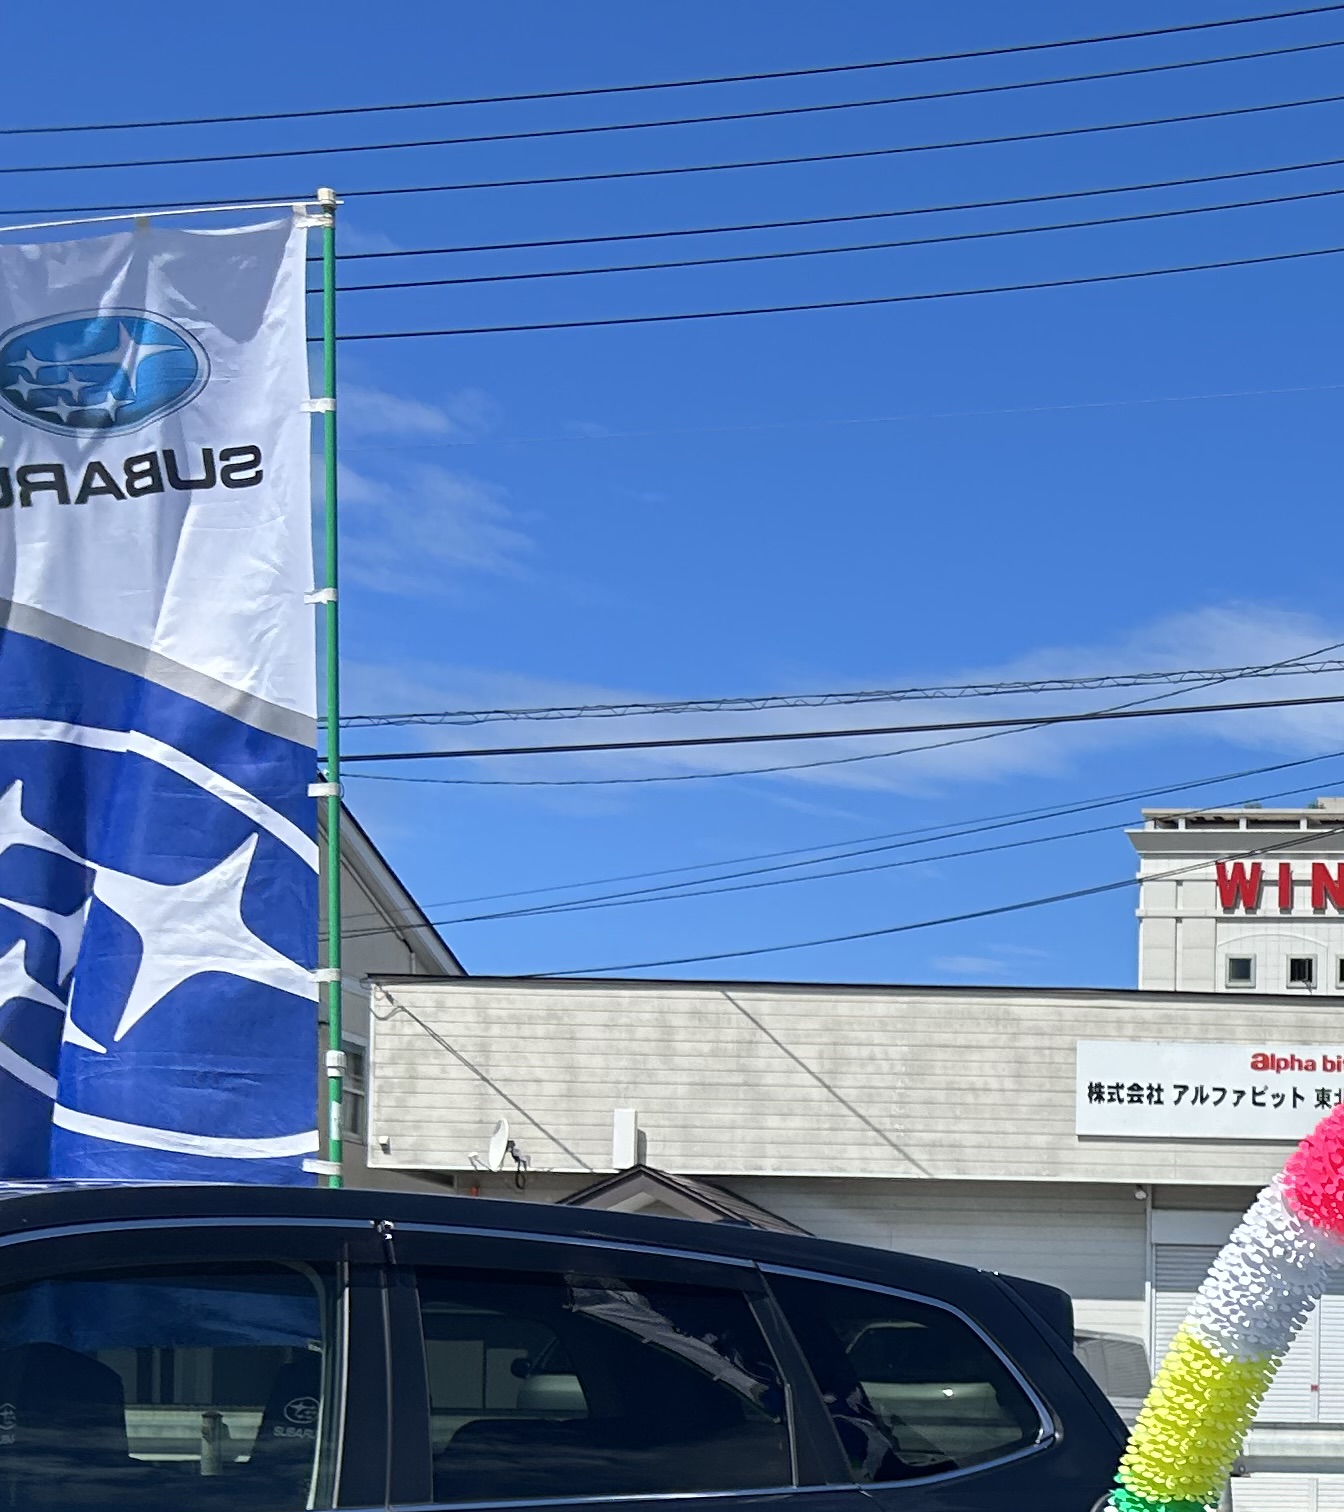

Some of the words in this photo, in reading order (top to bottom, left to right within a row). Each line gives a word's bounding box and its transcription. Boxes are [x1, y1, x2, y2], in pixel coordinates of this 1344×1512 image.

[1250, 1053, 1317, 1074] alpha
[1087, 1081, 1164, 1106] 株式会社
[1173, 1084, 1305, 1109] アルファビット
